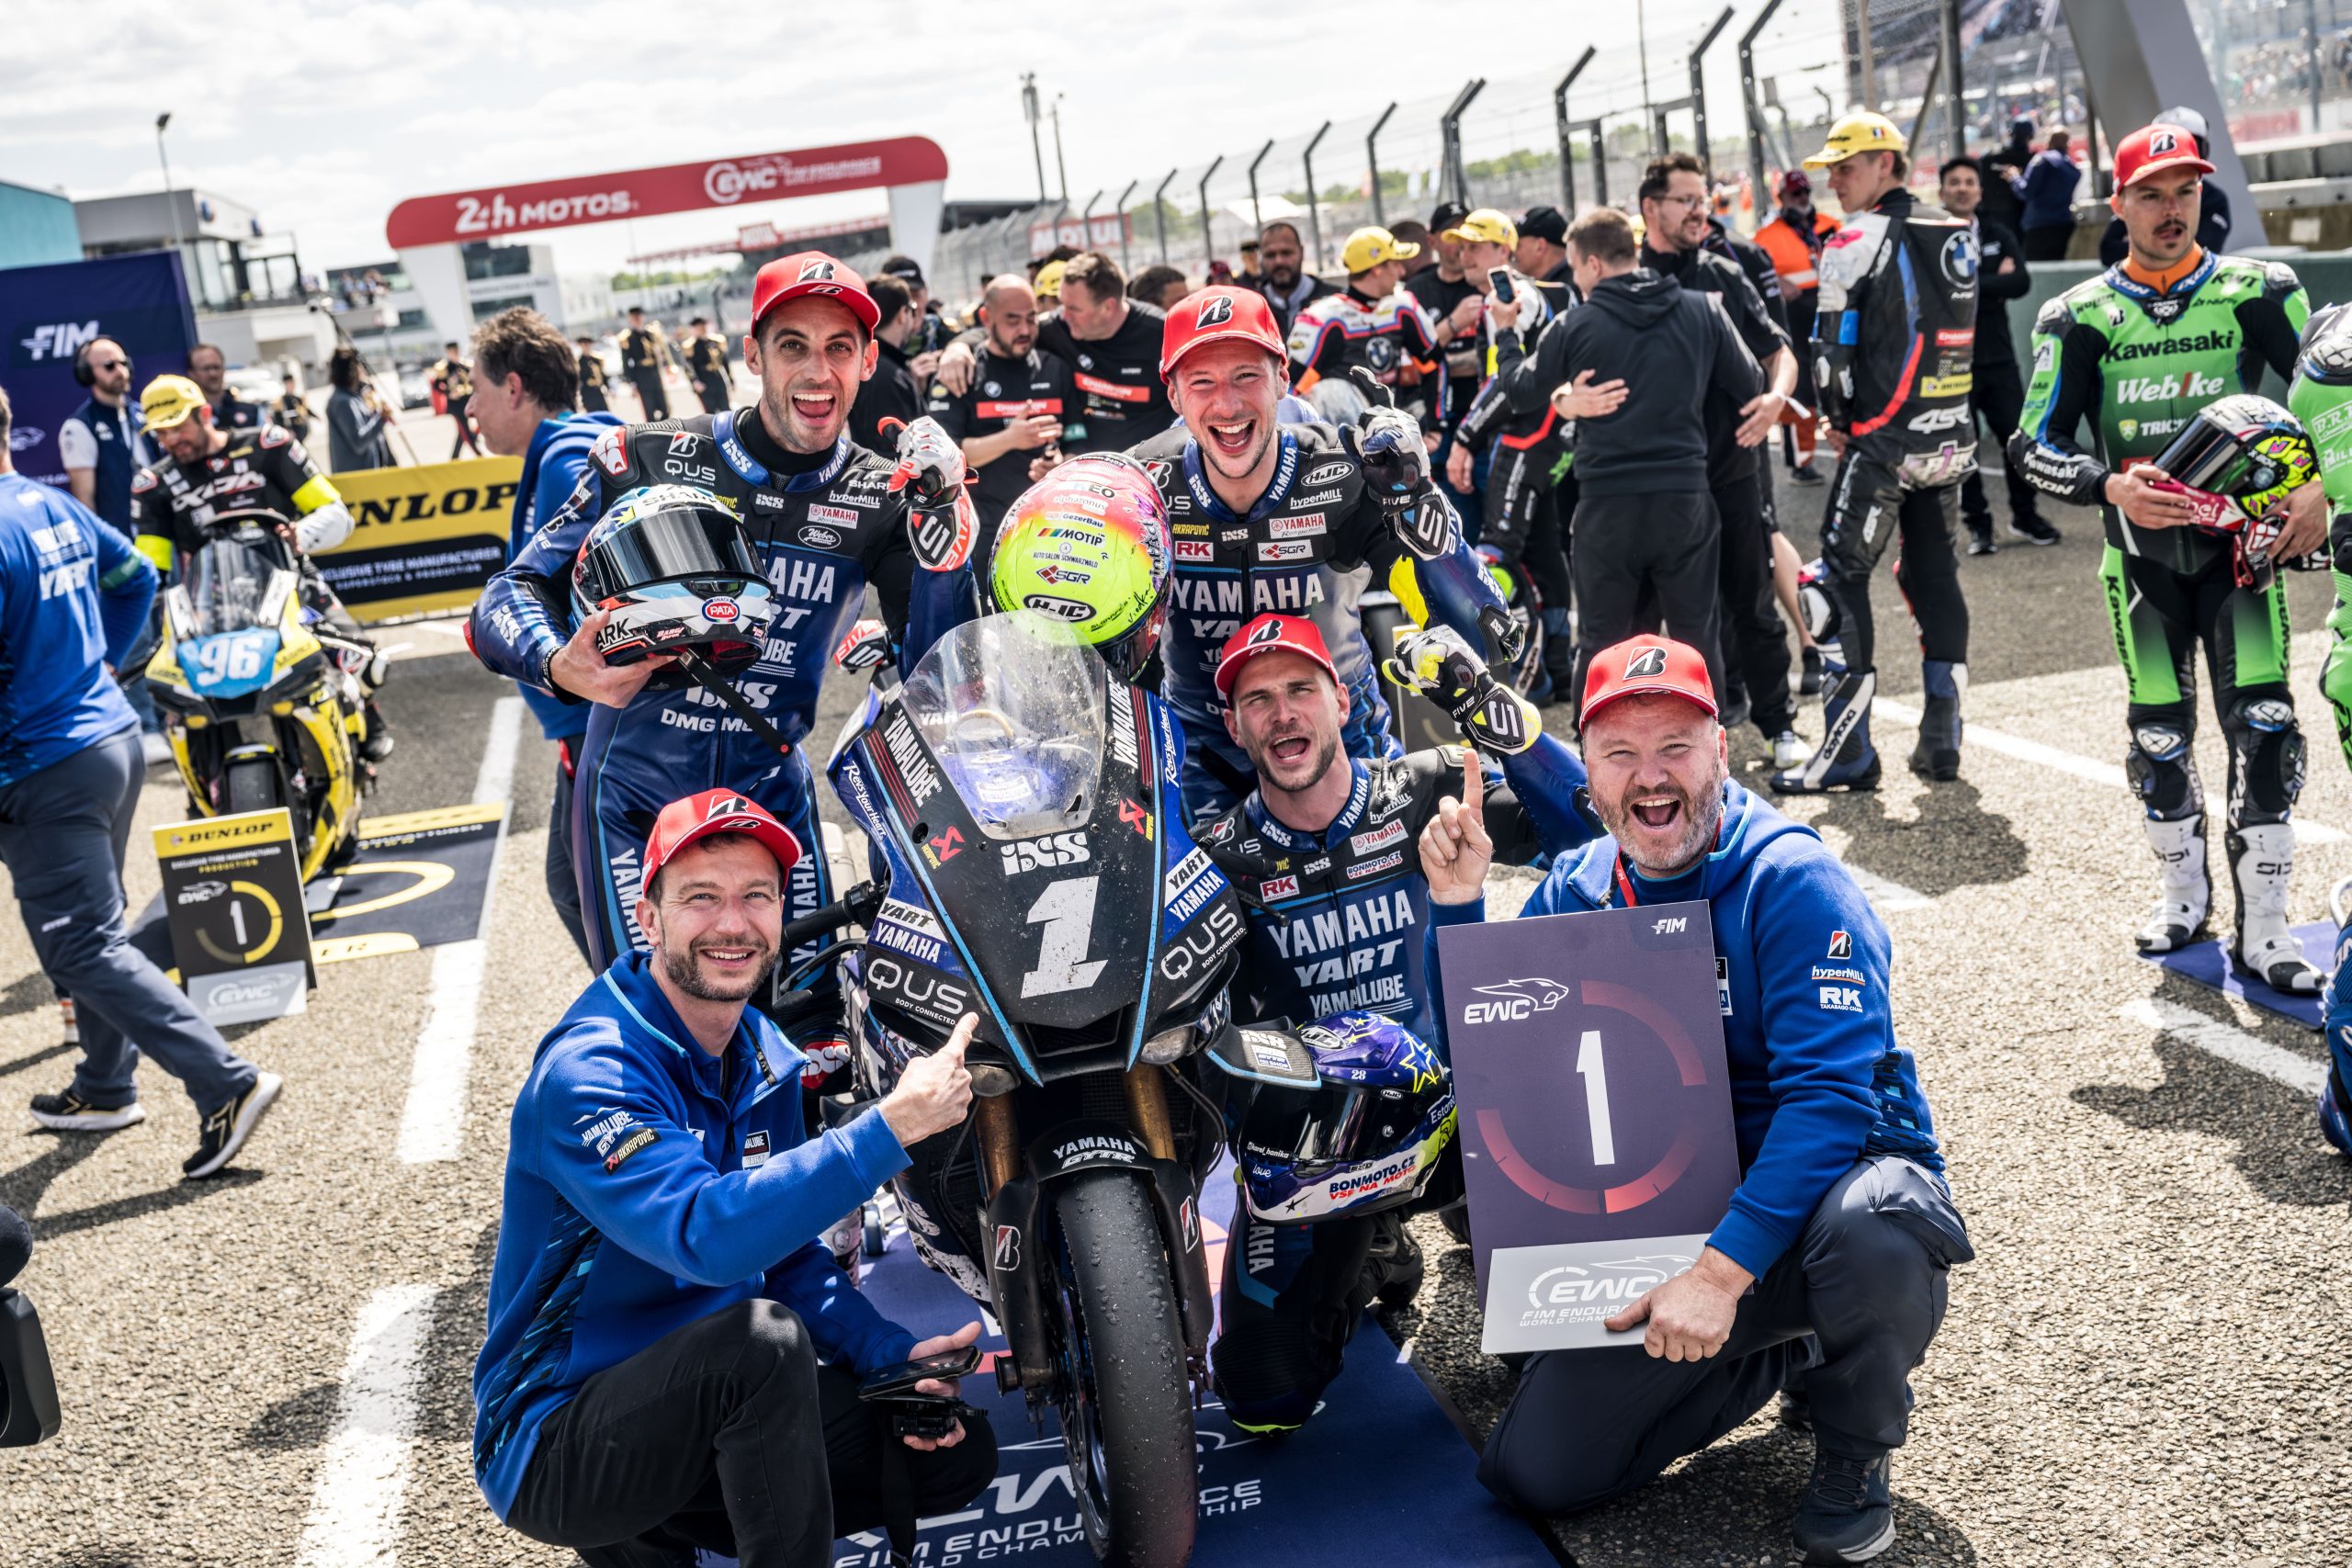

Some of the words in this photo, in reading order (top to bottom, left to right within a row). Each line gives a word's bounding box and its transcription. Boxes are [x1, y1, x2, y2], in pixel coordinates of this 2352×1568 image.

[520, 191, 630, 225] MOTOS
[20, 321, 100, 361] FIM
[2104, 331, 2234, 364] Kawasaki
[664, 459, 717, 481] QUS
[819, 439, 848, 483] YAMAHA
[1269, 446, 1298, 501] YAMAHA
[1308, 463, 1348, 484] HJC
[1290, 489, 1343, 508] hyperMILL
[1383, 495, 1411, 505] FIVE
[821, 507, 857, 522] YAMAHA
[1284, 514, 1325, 529] YAMAHA
[1059, 528, 1103, 547] MOTIP
[374, 558, 404, 574] TYRE
[405, 546, 502, 571] MANUFACTURER
[1176, 543, 1211, 557] RK
[1279, 545, 1306, 555] SGR
[1056, 570, 1091, 585] SGR
[1173, 573, 1326, 614] YAMAHA
[709, 605, 734, 615] PATA
[196, 637, 263, 687] 96
[1452, 696, 1476, 719] FIVE
[661, 708, 716, 732] DMG
[1109, 679, 1138, 770] YAMALUBE
[1823, 709, 1857, 761] daytona
[884, 708, 940, 808] YAMALUBE
[1339, 777, 1369, 830] YAMAHA
[188, 822, 274, 844] DUNLOP
[1364, 821, 1404, 845] YAMAHA
[1169, 852, 1207, 890] YART
[1347, 851, 1402, 874] BONMOTO.CZ
[1379, 857, 1403, 870] MOTO
[177, 887, 212, 906] EWC
[1169, 870, 1225, 922] YAMAHA
[1261, 875, 1296, 897] RK
[230, 899, 248, 945] 1
[880, 901, 934, 929] YART
[1267, 889, 1417, 960] YAMAHA
[1651, 918, 1689, 935] FIM
[875, 922, 942, 964] YAMAHA
[1020, 875, 1110, 999] 1
[1160, 903, 1238, 981] QUS
[1201, 953, 1216, 969] BODY
[1295, 939, 1404, 987] YART
[867, 958, 967, 1015] QUS
[1812, 965, 1866, 984] hyperMILL
[895, 998, 914, 1010] BODY
[1309, 974, 1406, 1019] YAMALUBE
[1819, 987, 1863, 1009] RK
[1820, 1003, 1849, 1011] TAKASAGO
[1464, 998, 1532, 1025] EWC
[1351, 1069, 1367, 1081] 28
[1577, 1030, 1615, 1166] 1
[1053, 1136, 1137, 1159] YAMAHA
[1329, 1155, 1417, 1193] BONMOTO.CZ
[1360, 1182, 1378, 1192] NA
[1383, 1165, 1417, 1185] MOTO
[1548, 1276, 1659, 1304] EWC
[1520, 1318, 1565, 1327] WORLD
[1522, 1309, 1556, 1321] FIM
